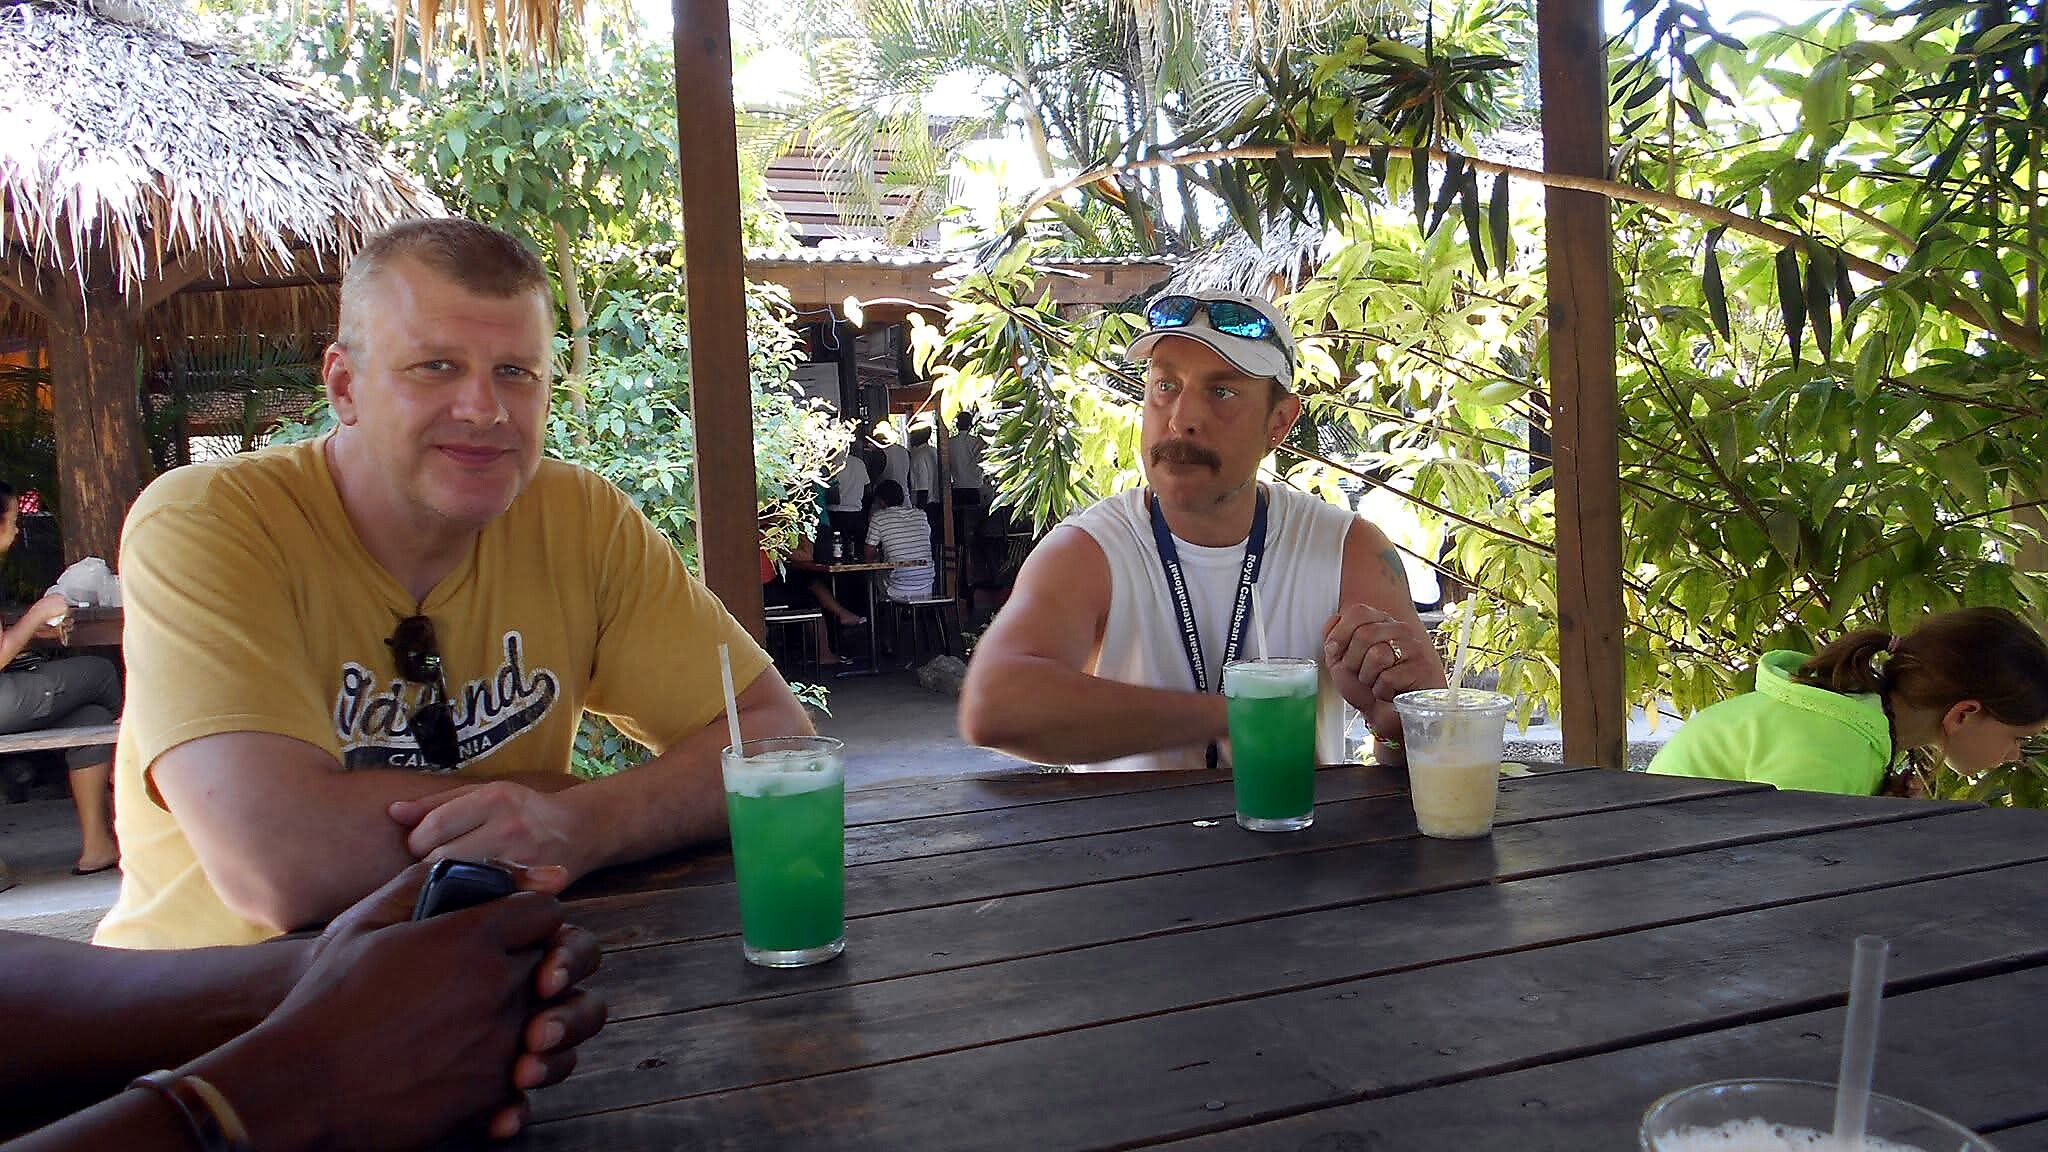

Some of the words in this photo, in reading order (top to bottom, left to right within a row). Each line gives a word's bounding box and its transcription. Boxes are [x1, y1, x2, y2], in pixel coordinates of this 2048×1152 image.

[1242, 554, 1257, 585] Royal
[1169, 562, 1195, 633] International
[1231, 586, 1249, 641] Caribbean
[388, 737, 493, 768] CALNIA
